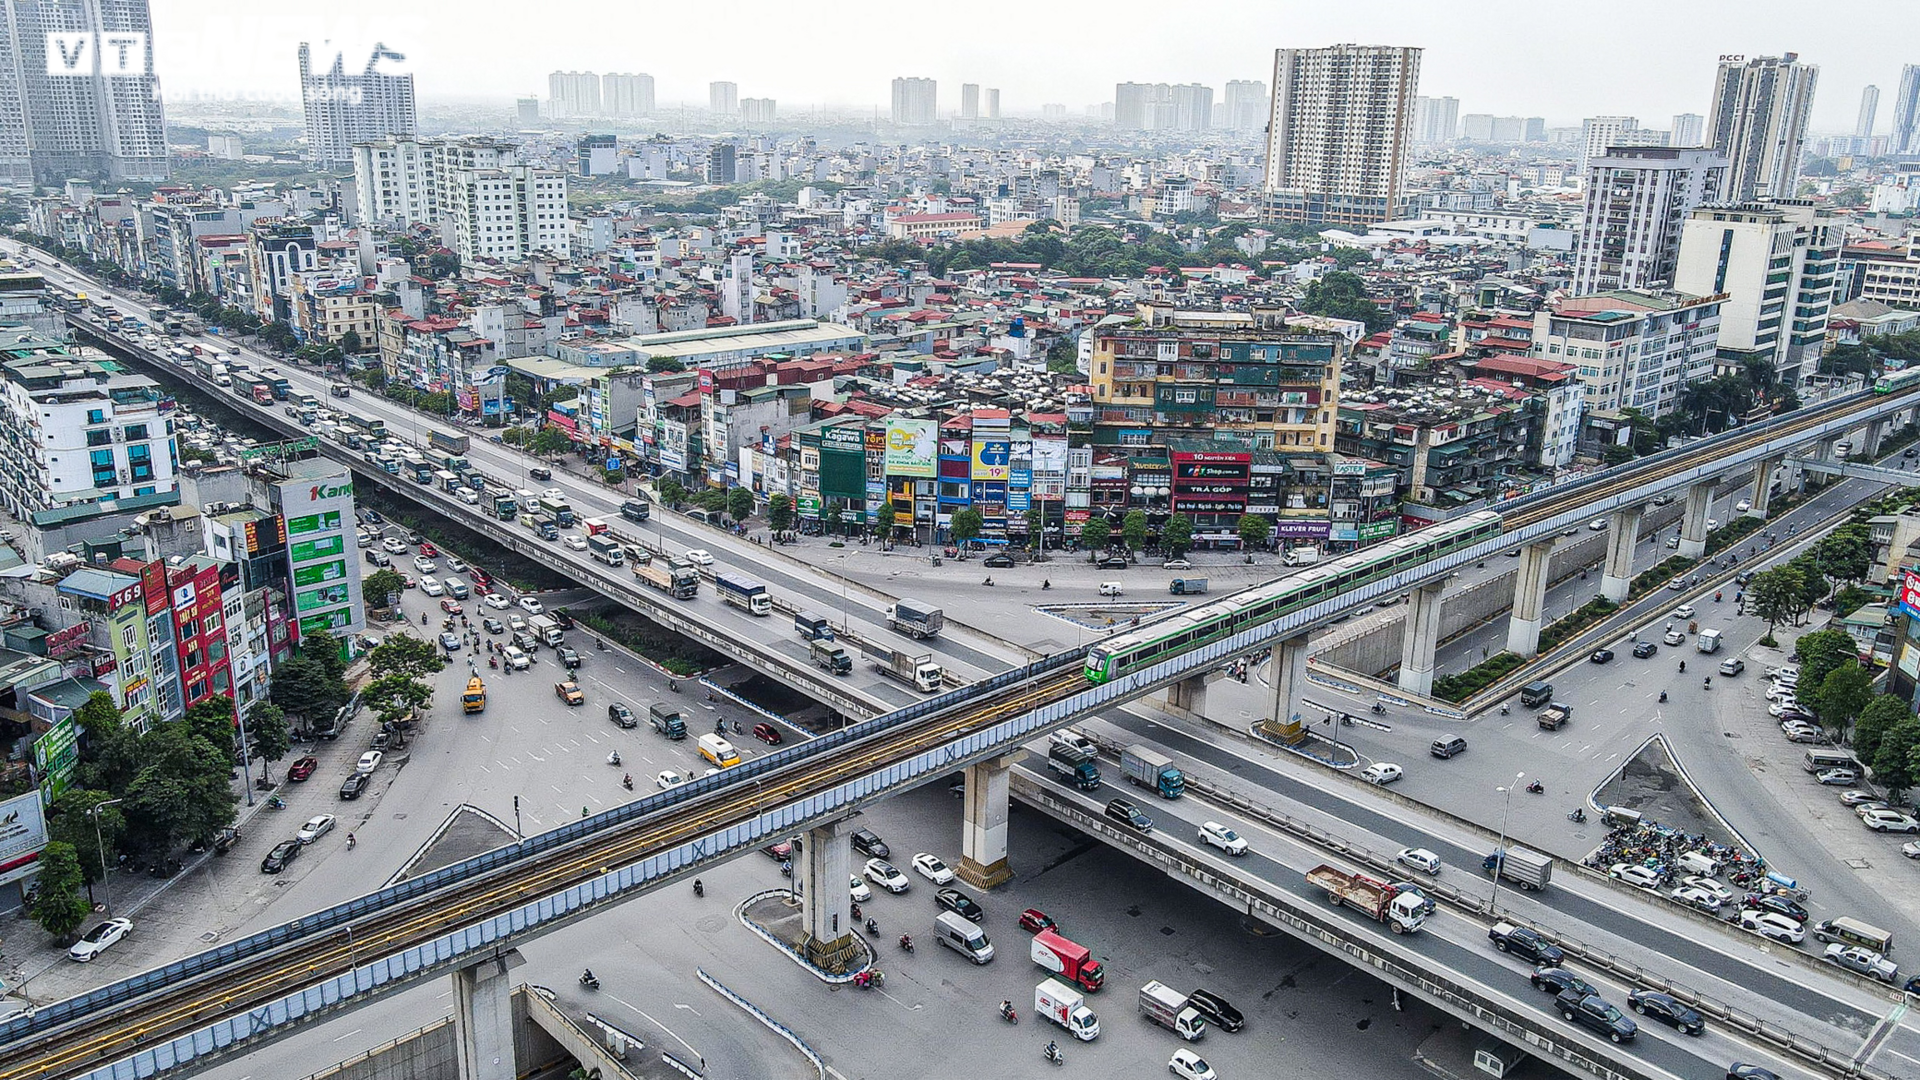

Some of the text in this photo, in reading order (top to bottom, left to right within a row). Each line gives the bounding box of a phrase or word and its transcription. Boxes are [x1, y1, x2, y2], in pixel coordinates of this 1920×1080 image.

[1718, 54, 1745, 62] PCC1
[254, 216, 283, 224] HOTEL
[825, 432, 860, 442] Kagawa
[1188, 465, 1206, 476] FPT
[114, 585, 141, 607] 369
[95, 653, 115, 667] Club
[96, 660, 116, 675] 367
